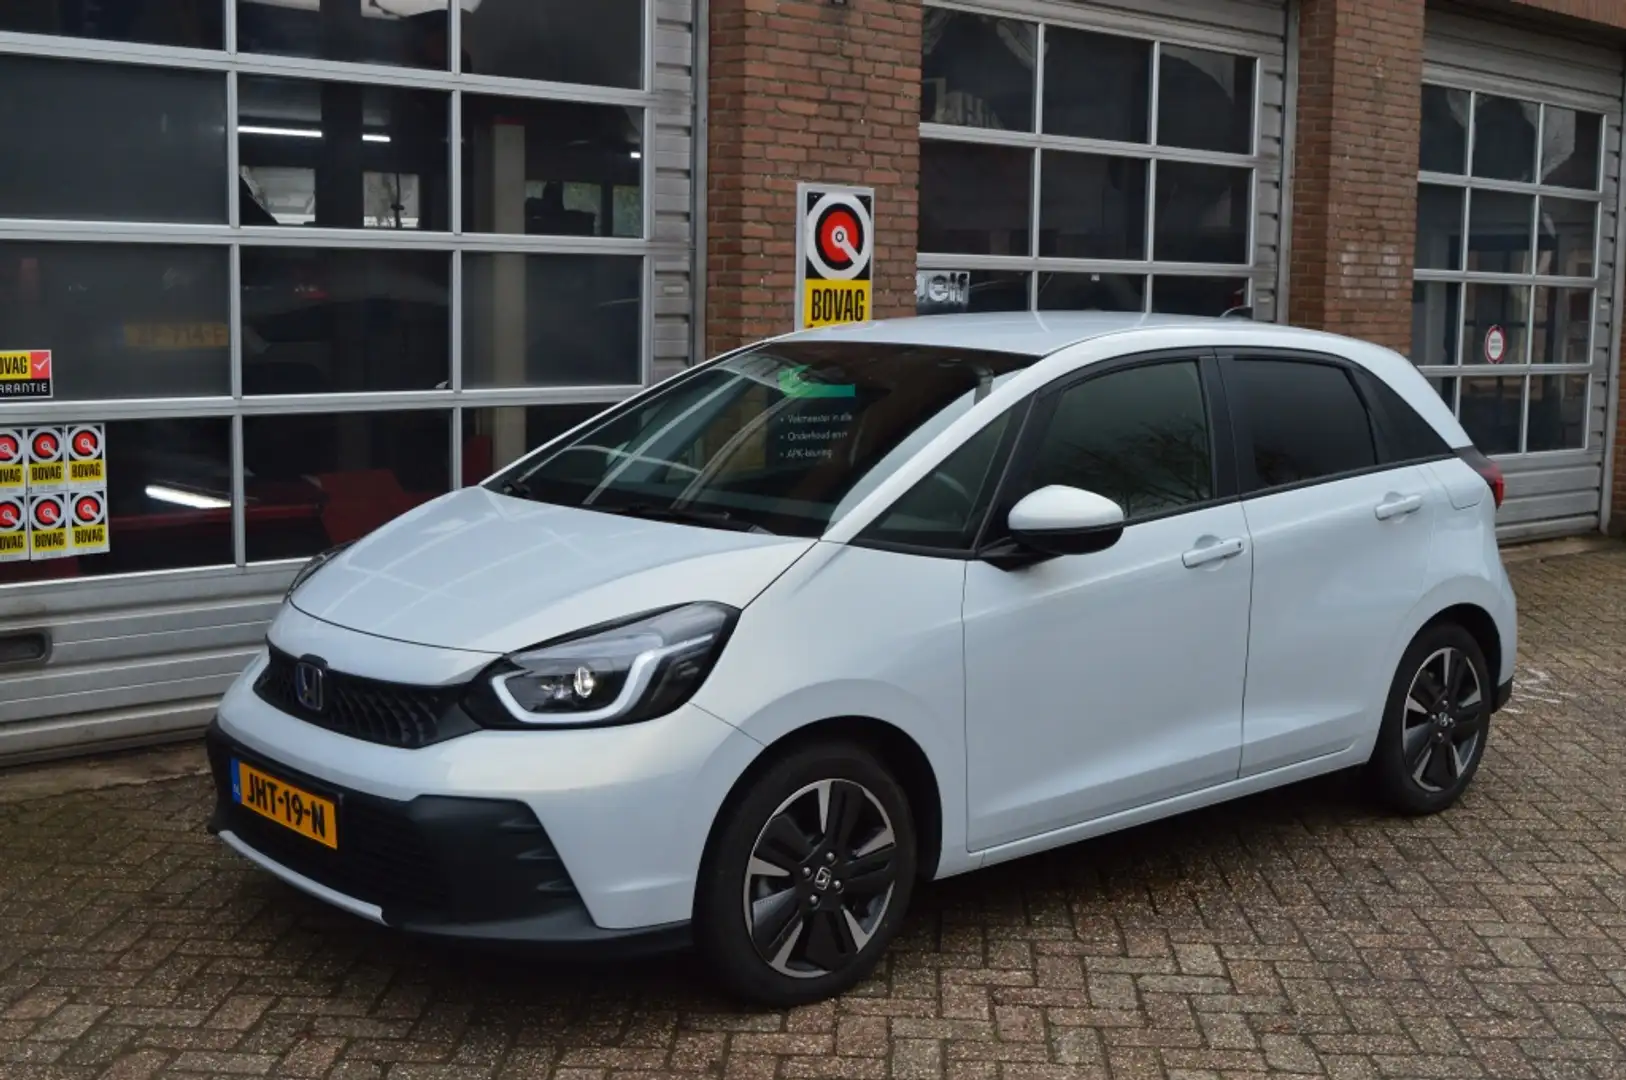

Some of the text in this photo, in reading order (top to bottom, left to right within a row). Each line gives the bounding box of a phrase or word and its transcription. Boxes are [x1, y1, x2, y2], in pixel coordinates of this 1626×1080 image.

[811, 288, 865, 321] BOVAG
[32, 466, 62, 481] BOVAG
[71, 463, 101, 478] BOVAG
[35, 532, 65, 548] BOVAG
[74, 528, 104, 544] BOVAG
[247, 772, 326, 839] JHT-19-N
